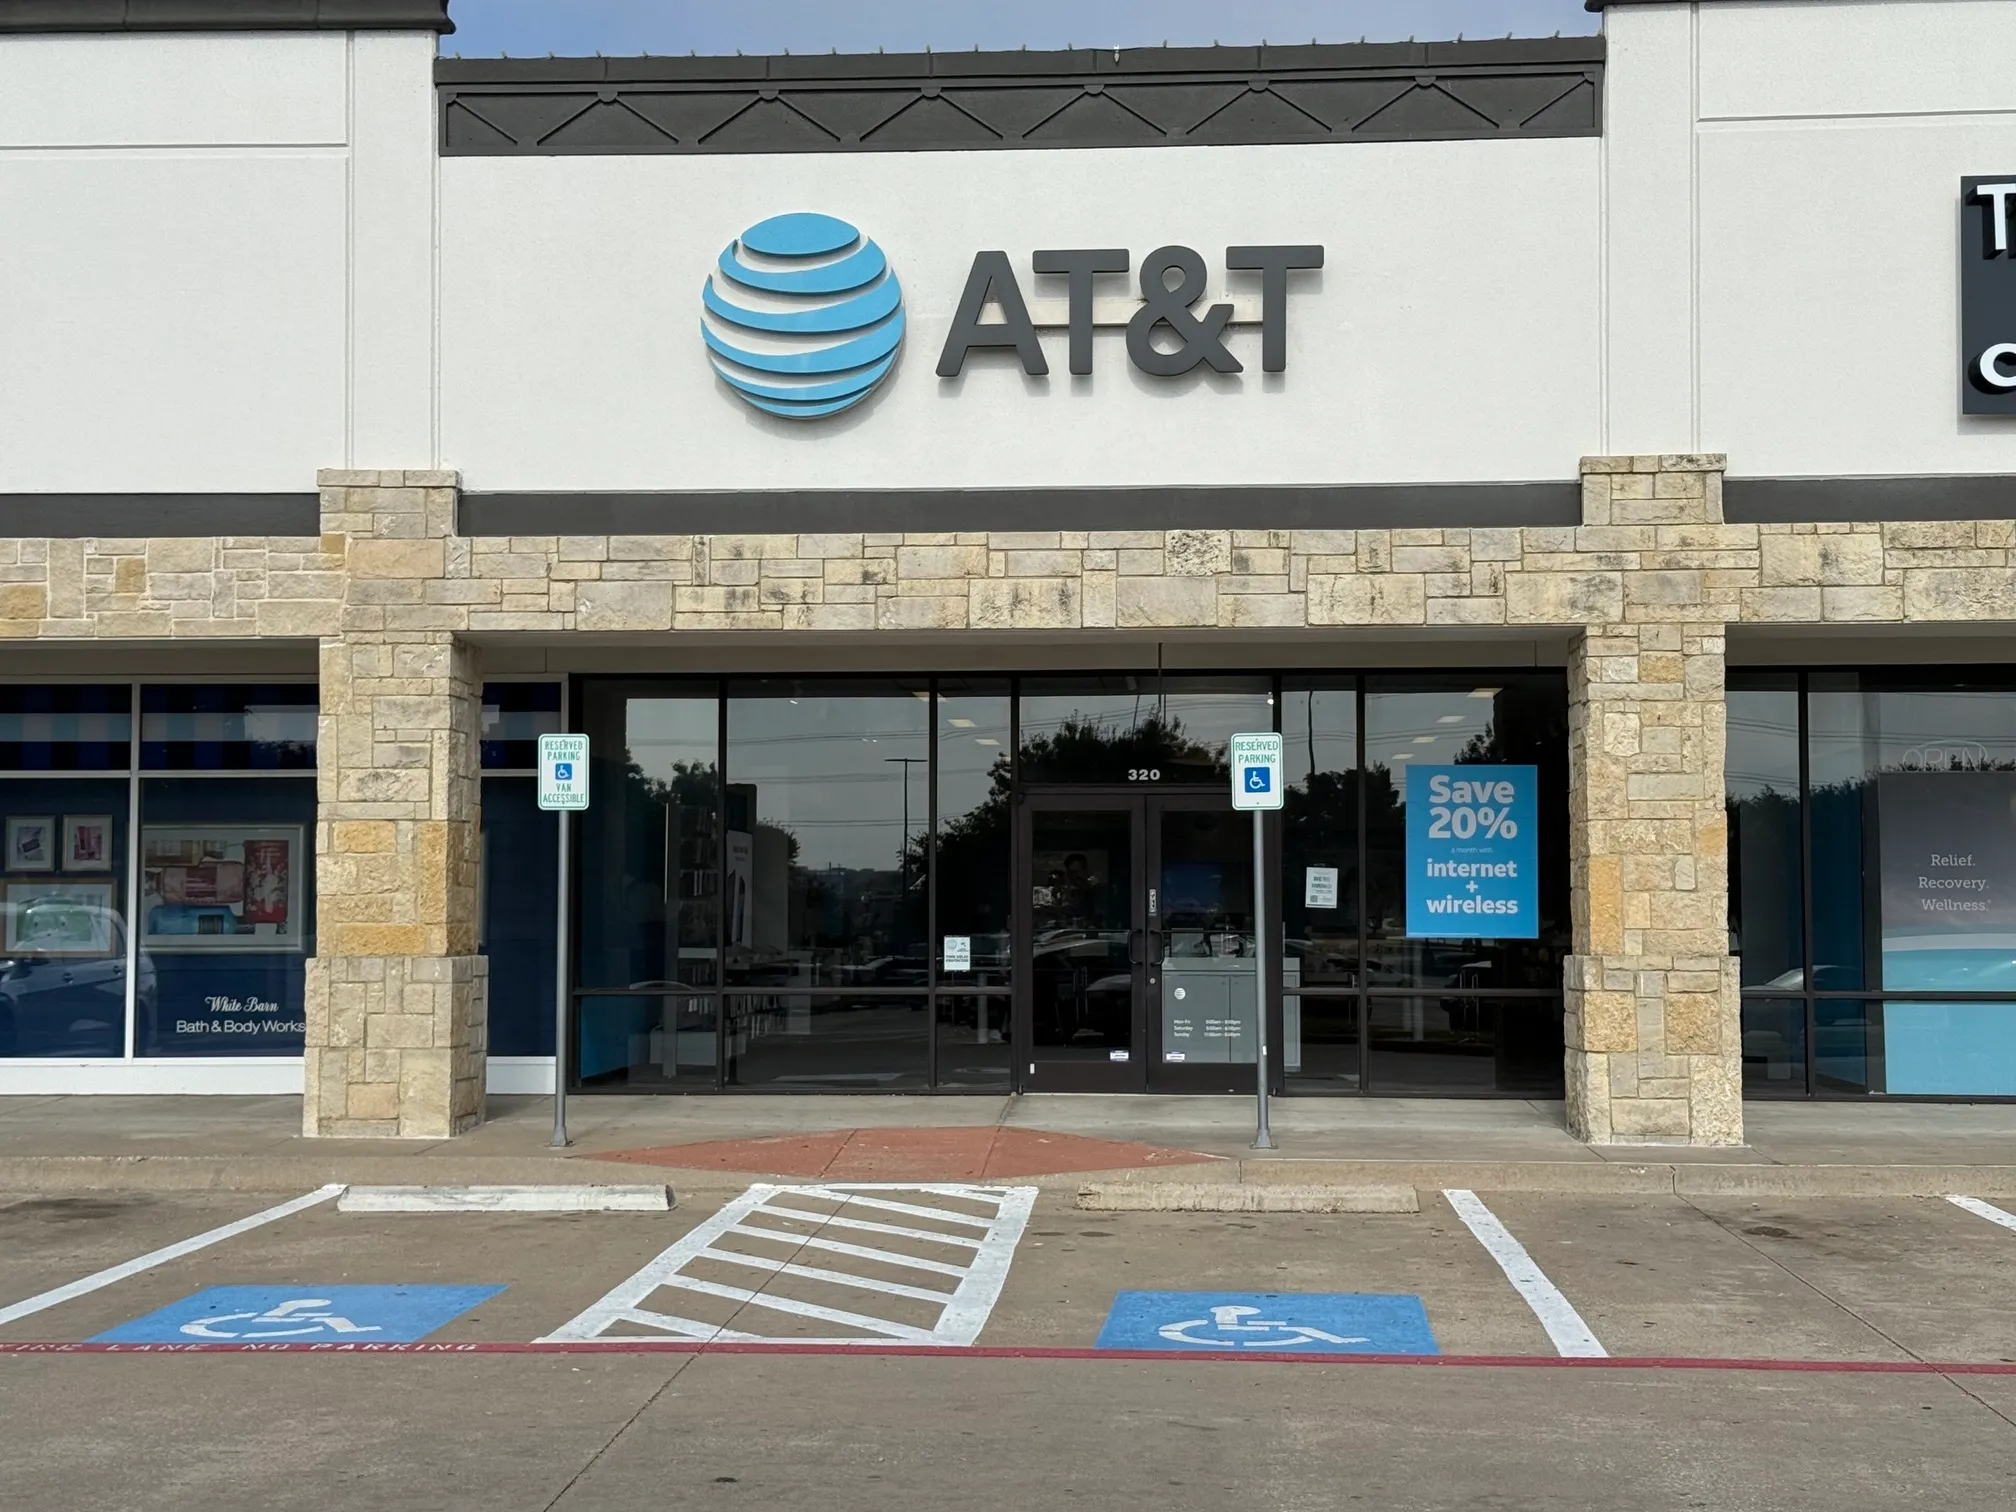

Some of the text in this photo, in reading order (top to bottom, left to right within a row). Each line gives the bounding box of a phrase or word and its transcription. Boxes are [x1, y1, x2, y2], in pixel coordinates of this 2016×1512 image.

[935, 244, 1325, 378] AT&T
[544, 740, 583, 750] RESERVED
[1236, 741, 1278, 751] RESERVED
[547, 751, 580, 760] PARKING
[1238, 754, 1276, 764] PARKING
[1128, 769, 1161, 780] 320
[556, 783, 572, 792] VAN
[1428, 774, 1515, 804] Save
[543, 794, 584, 803] ACCESSIBLE
[1428, 806, 1518, 839] 20%
[1930, 854, 1976, 866] Relief.
[1426, 858, 1518, 878] internet
[1918, 876, 1989, 891] Recovery.
[1426, 894, 1518, 914] wireless
[204, 996, 279, 1012] White Barn
[176, 1020, 306, 1035] Bath & Body Works
